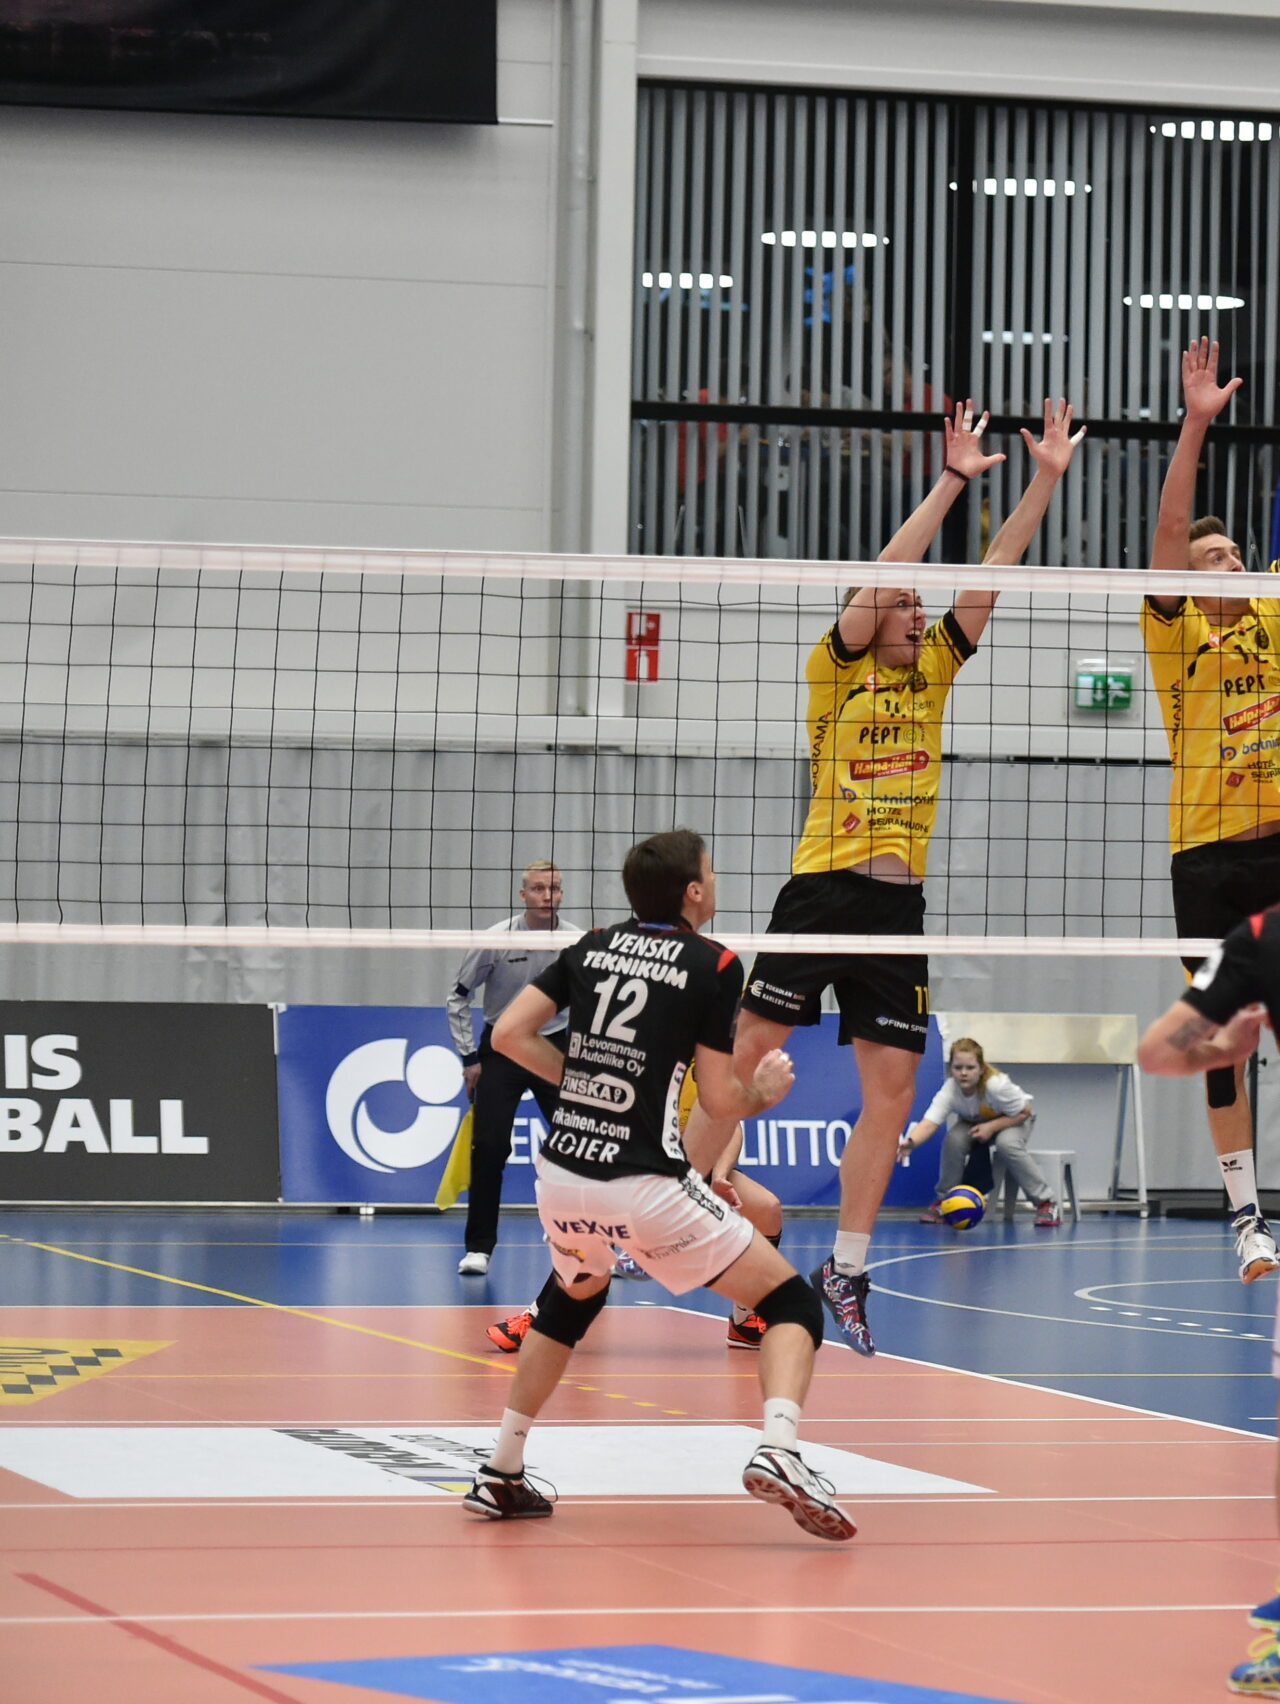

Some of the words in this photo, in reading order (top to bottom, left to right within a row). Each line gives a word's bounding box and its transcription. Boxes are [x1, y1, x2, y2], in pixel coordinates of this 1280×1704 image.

[859, 726, 901, 744] PEPT
[608, 932, 684, 962] VENSKI
[583, 951, 688, 990] TEKNIKUM
[590, 974, 649, 1043] 12
[888, 1019, 909, 1030] FINN
[4, 1034, 83, 1091] IS
[580, 1049, 625, 1069] Autoliike
[626, 1060, 646, 1077] Oy
[582, 1035, 646, 1061] Levorannan
[0, 1098, 209, 1154] BALL
[552, 1107, 630, 1141] rikainen.com
[553, 1219, 631, 1240] VEXVE
